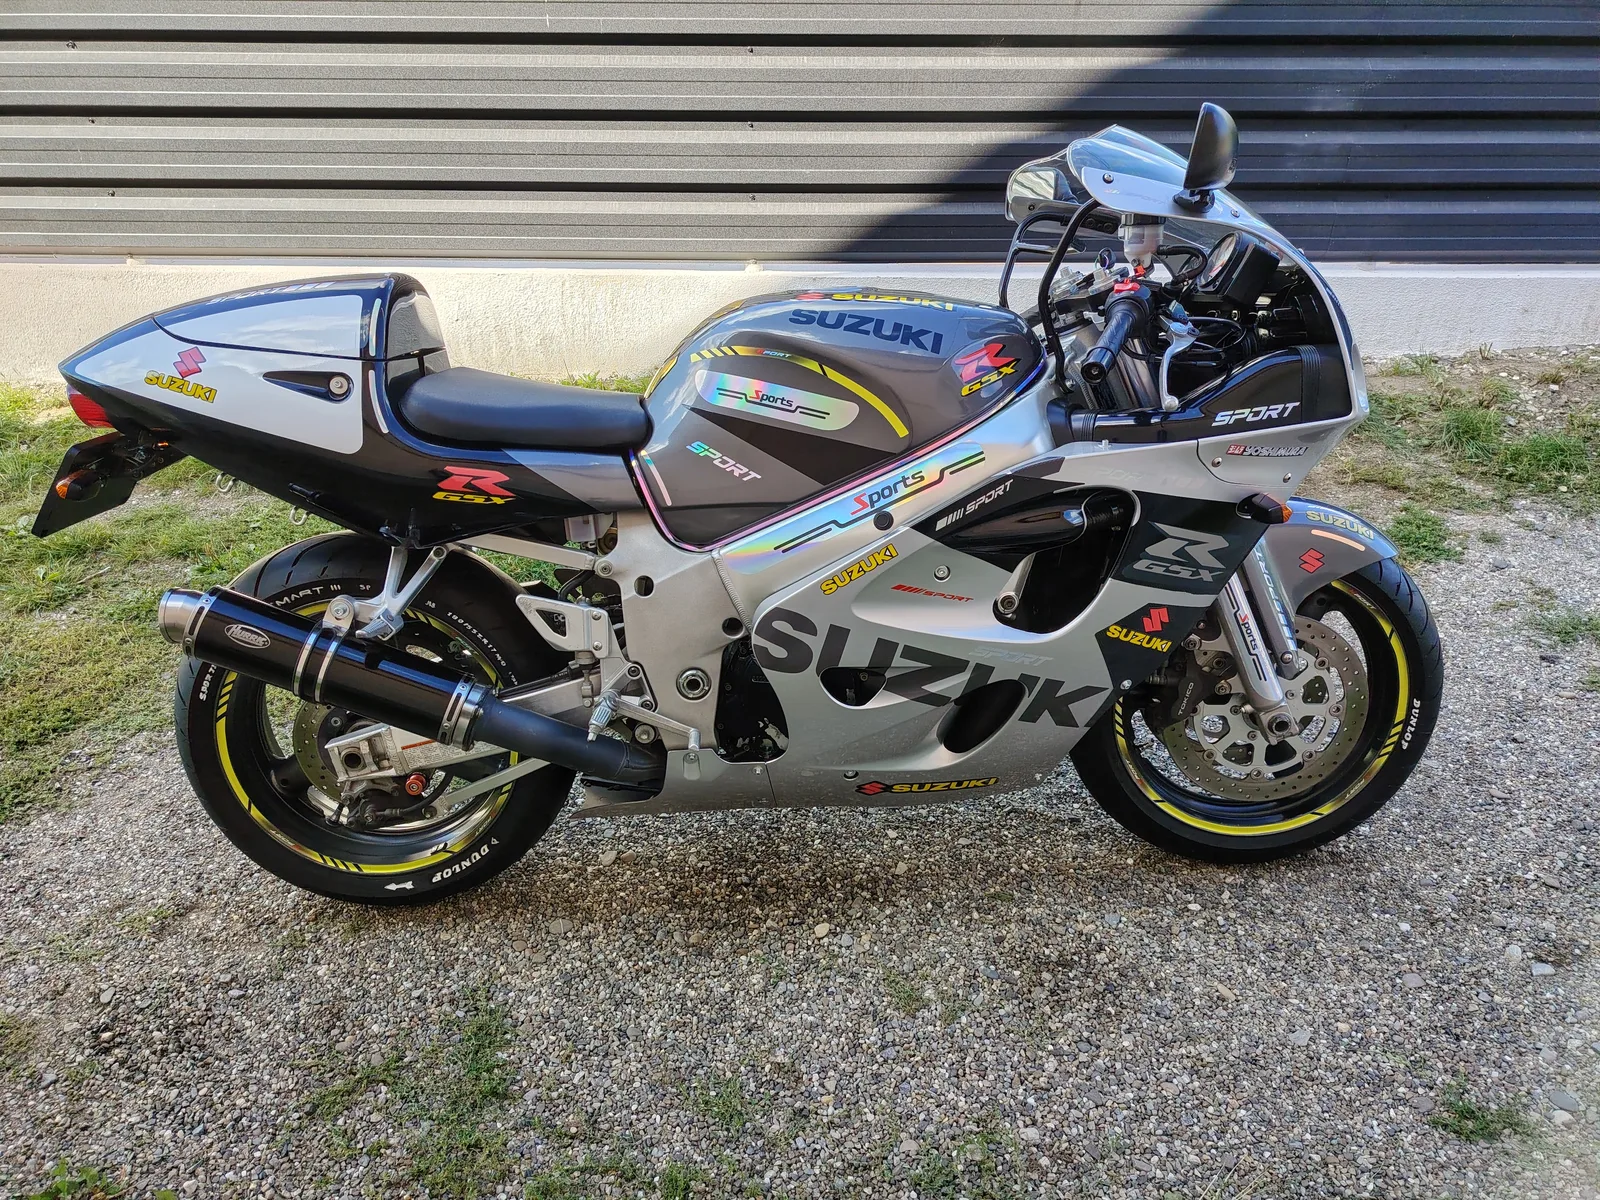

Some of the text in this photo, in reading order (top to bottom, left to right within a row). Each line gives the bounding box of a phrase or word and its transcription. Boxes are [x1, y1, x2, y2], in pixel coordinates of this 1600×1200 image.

[831, 293, 954, 311] SUZUKI
[789, 309, 944, 354] SUZUKI
[144, 370, 217, 403] SUZUKI
[961, 361, 1018, 397] GSX
[749, 390, 794, 408] Sports
[1212, 401, 1300, 427] SPORT
[685, 440, 762, 482] SPORT
[1242, 445, 1309, 457] YOSHIMURA
[432, 491, 517, 505] GSX
[850, 470, 926, 515] Sports
[965, 479, 1014, 515] SPORT
[1306, 510, 1375, 540] SUZUKI
[820, 543, 899, 596] SUZUKI
[1132, 558, 1224, 582] GSX
[270, 586, 324, 607] MART
[924, 590, 975, 603] SPORT
[1106, 625, 1173, 653] SUZUKI
[1238, 613, 1258, 651] Sports
[969, 645, 1054, 667] SPORT
[1177, 682, 1194, 716] TOKICO
[1401, 698, 1420, 750] DUNLOP
[891, 777, 999, 794] SUZUKI
[431, 844, 490, 883] DUNLOP
